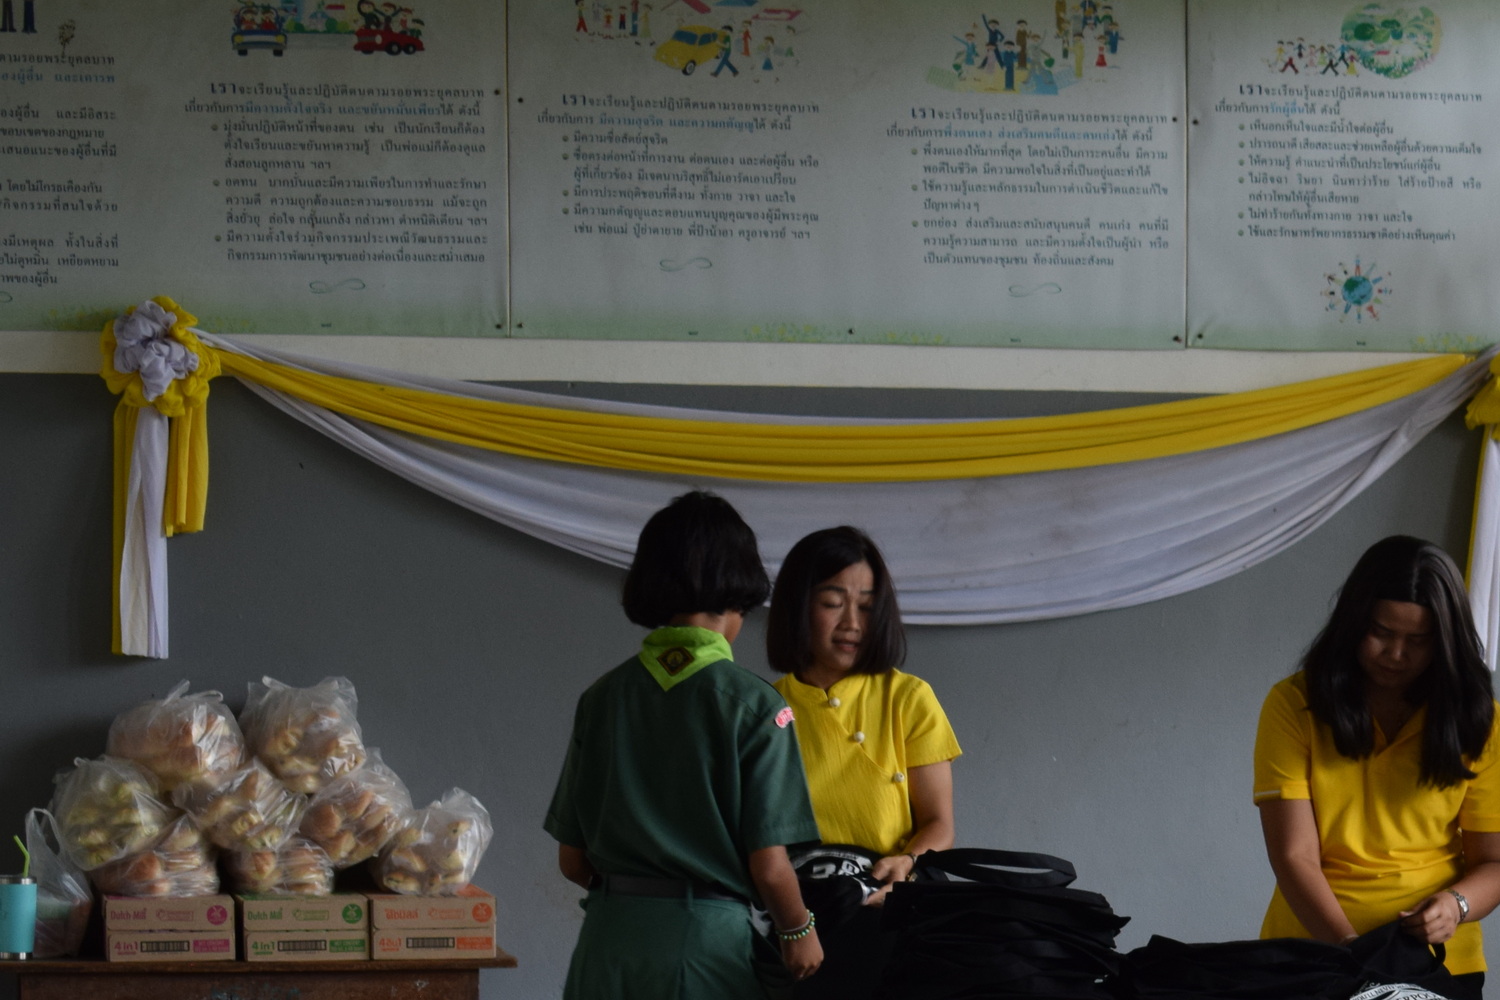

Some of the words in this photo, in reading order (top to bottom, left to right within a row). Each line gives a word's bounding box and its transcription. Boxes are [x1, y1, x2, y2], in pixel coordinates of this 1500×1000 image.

[365, 120, 384, 133] เช่น
[226, 194, 261, 206] ความดี
[766, 192, 796, 203] และใจ
[574, 223, 592, 234] เช่น
[110, 911, 131, 920] Dutch
[248, 911, 268, 920] Dutch
